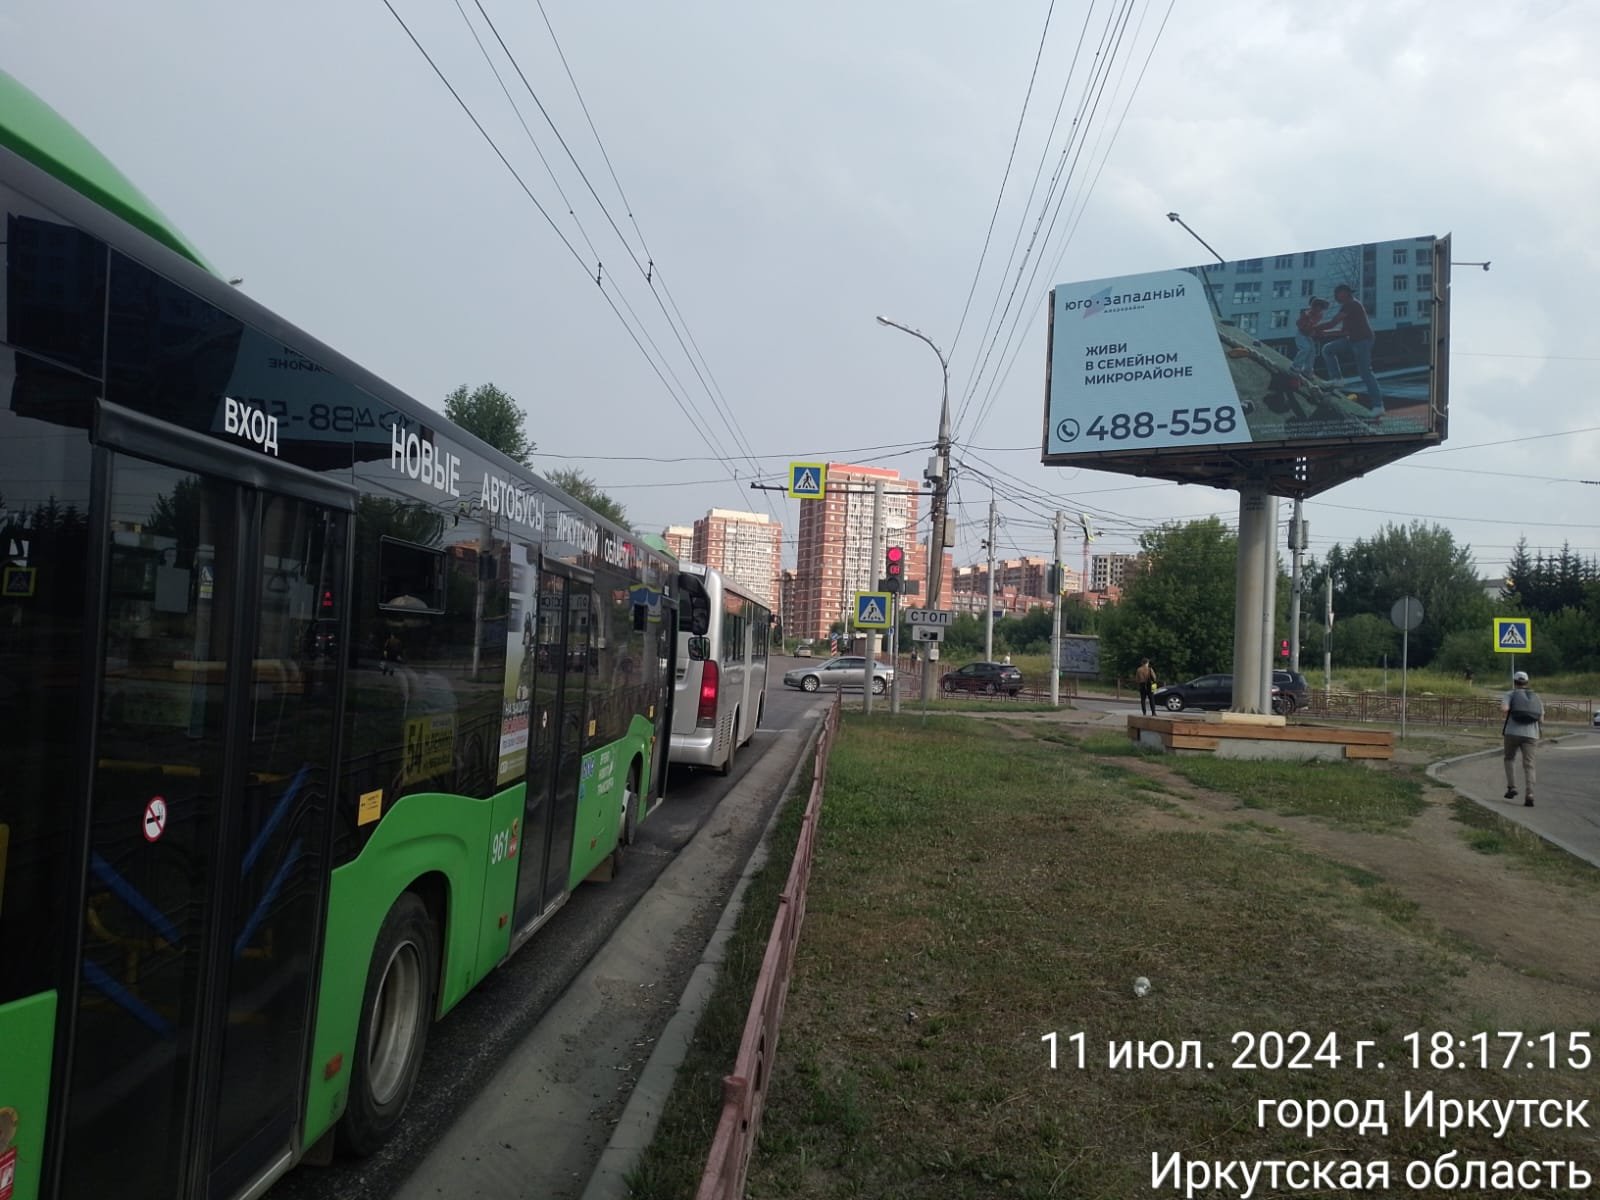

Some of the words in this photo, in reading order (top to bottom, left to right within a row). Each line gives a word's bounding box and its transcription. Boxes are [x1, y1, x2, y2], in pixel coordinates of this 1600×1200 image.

[1085, 342, 1128, 356] ЖИВИ
[1085, 361, 1095, 371] В
[1097, 352, 1179, 371] СЕМЕЙНОМ
[1084, 366, 1194, 385] МИКРОРАЙОНЕ
[224, 397, 279, 457] ВХОД
[1086, 405, 1237, 441] 488-558
[391, 423, 461, 498] НОВЫЕ
[480, 472, 545, 532] АВТОБУСЫ
[556, 509, 599, 557] ИРКУТСКОЙ
[910, 610, 948, 624] СТОП
[491, 827, 510, 865] 961
